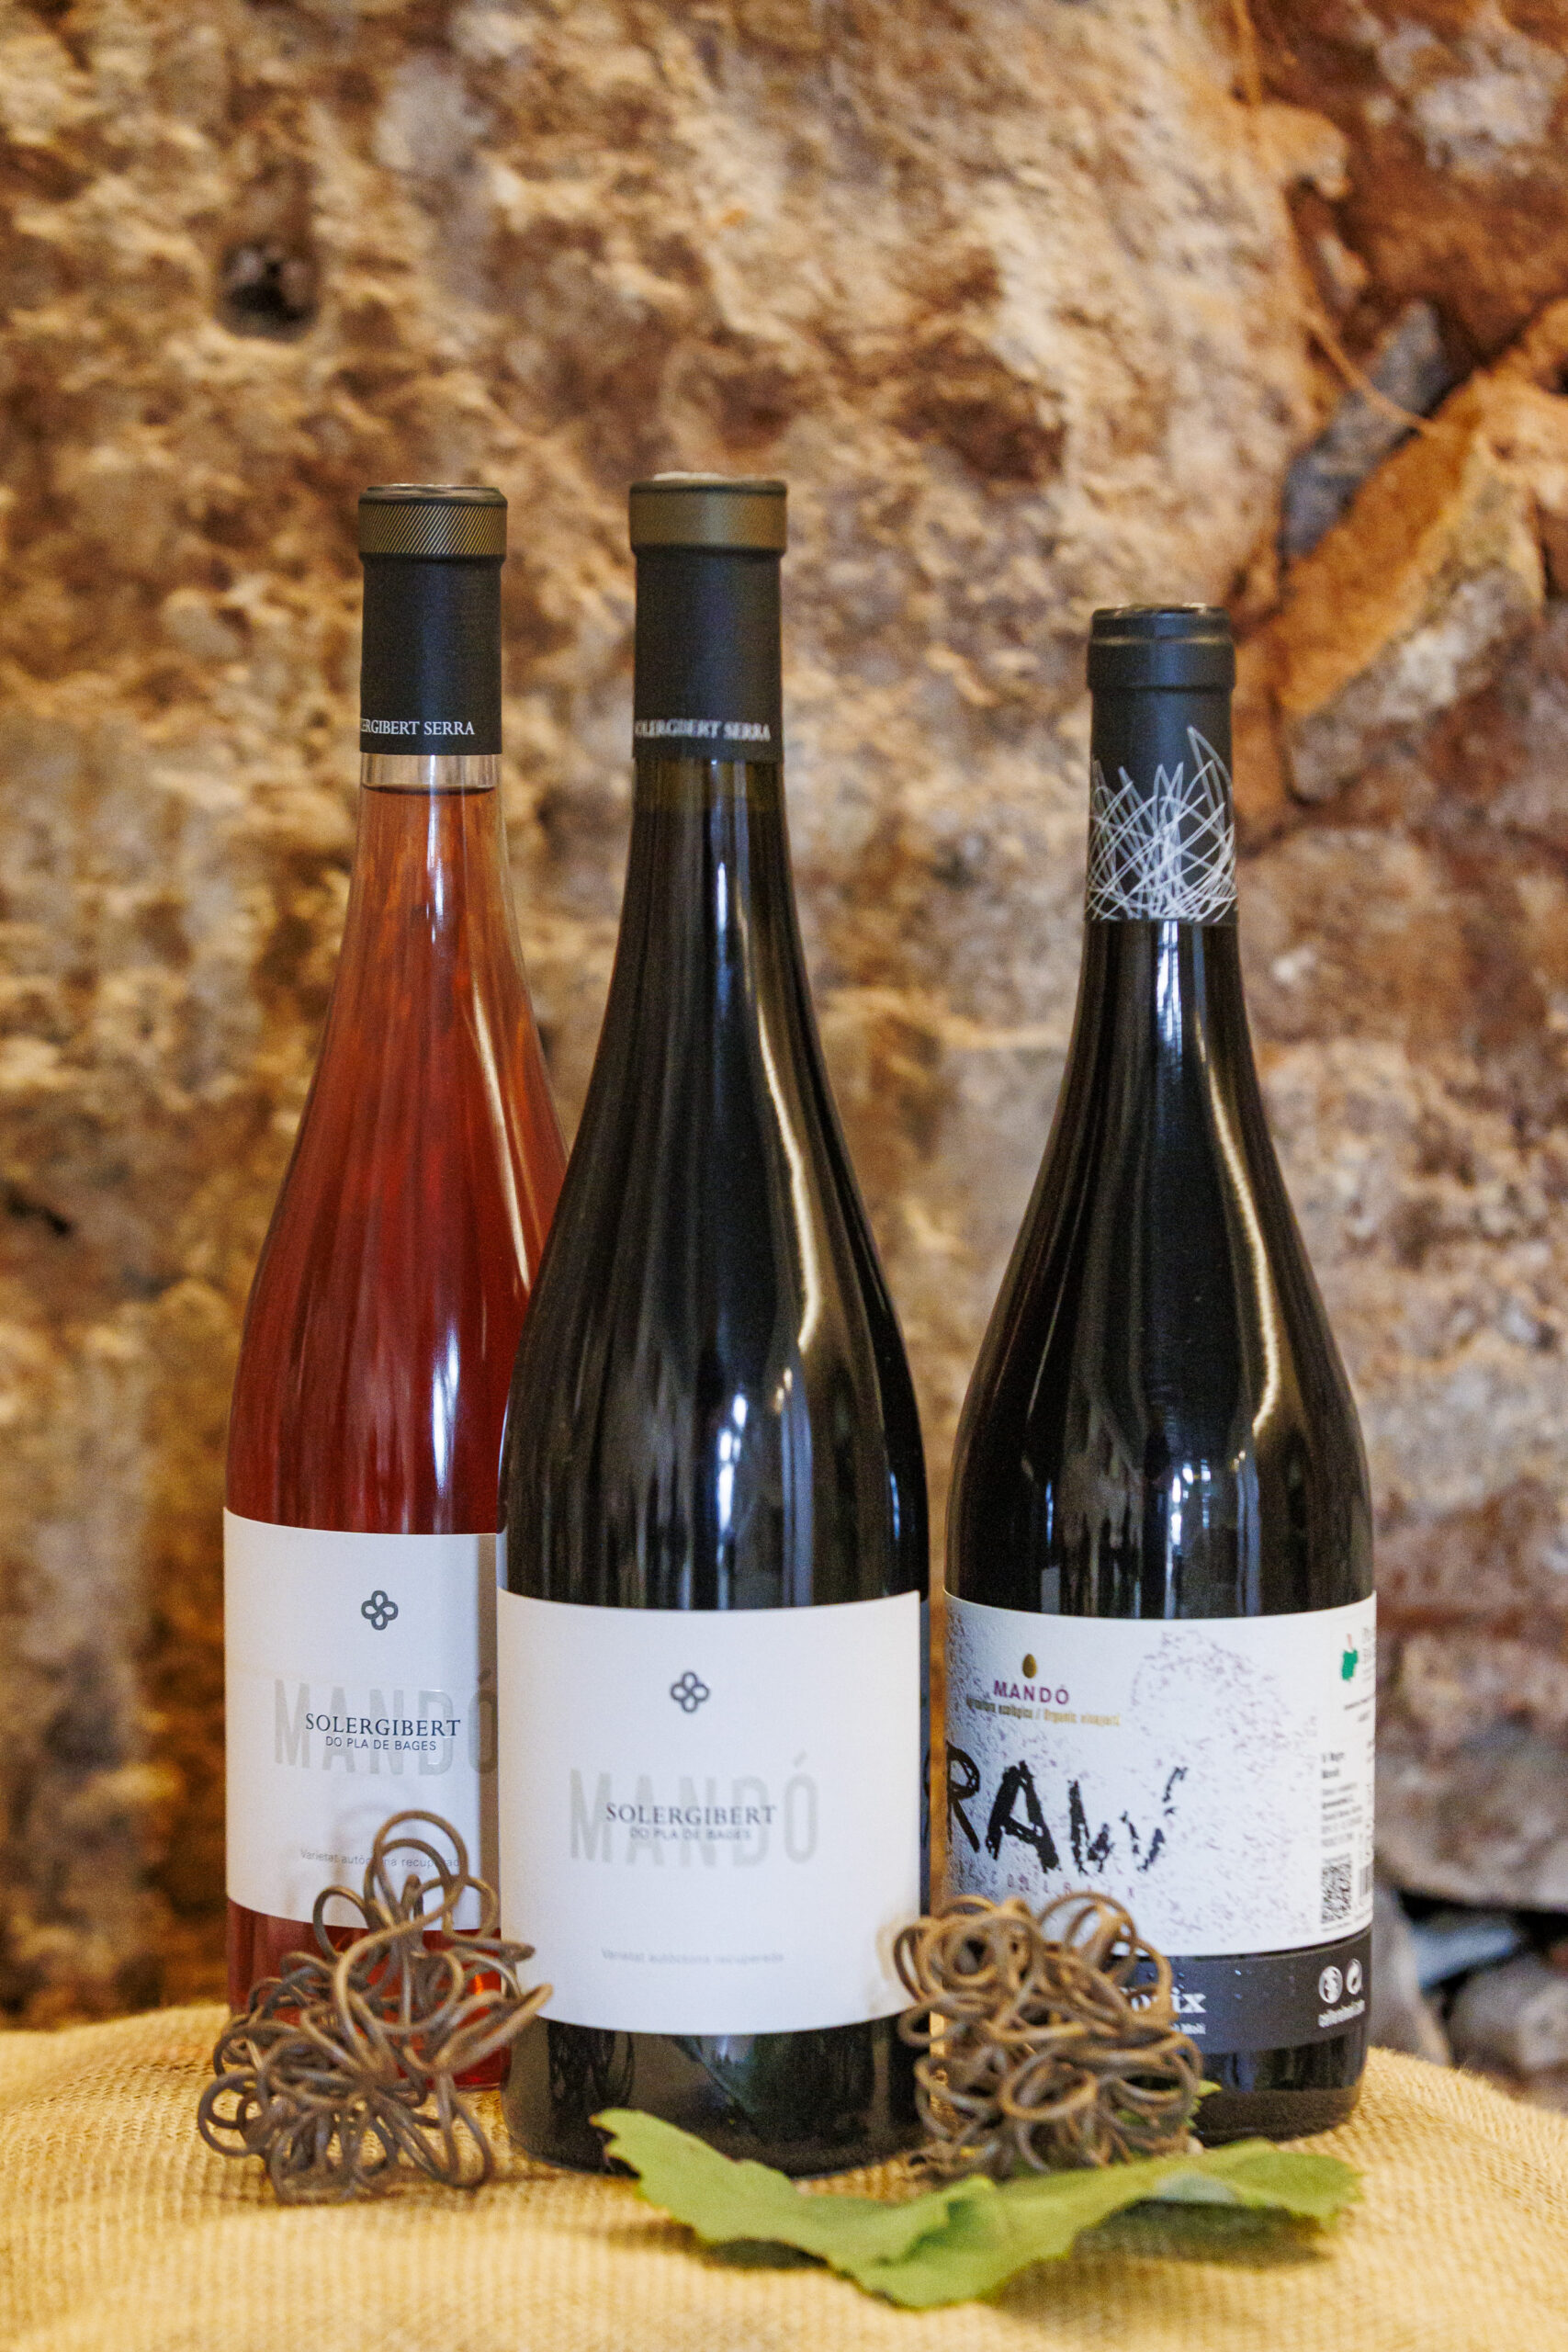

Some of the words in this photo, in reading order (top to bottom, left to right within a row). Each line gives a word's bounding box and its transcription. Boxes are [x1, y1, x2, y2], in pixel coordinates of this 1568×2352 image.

[423, 720, 476, 736] SERRA
[993, 1679, 1069, 1705] MANDÓ
[274, 1668, 498, 1776] MANDÓ
[305, 1713, 461, 1736] SOLERGIBERT
[325, 1736, 342, 1747] DO
[346, 1737, 368, 1749] PLA
[373, 1739, 389, 1751] DE
[394, 1740, 437, 1751] BAGES
[569, 1749, 819, 1868] MANDÓ
[604, 1802, 777, 1826] SOLERGIBERT
[341, 1853, 397, 1867] autòcna
[401, 1859, 465, 1869] recupad
